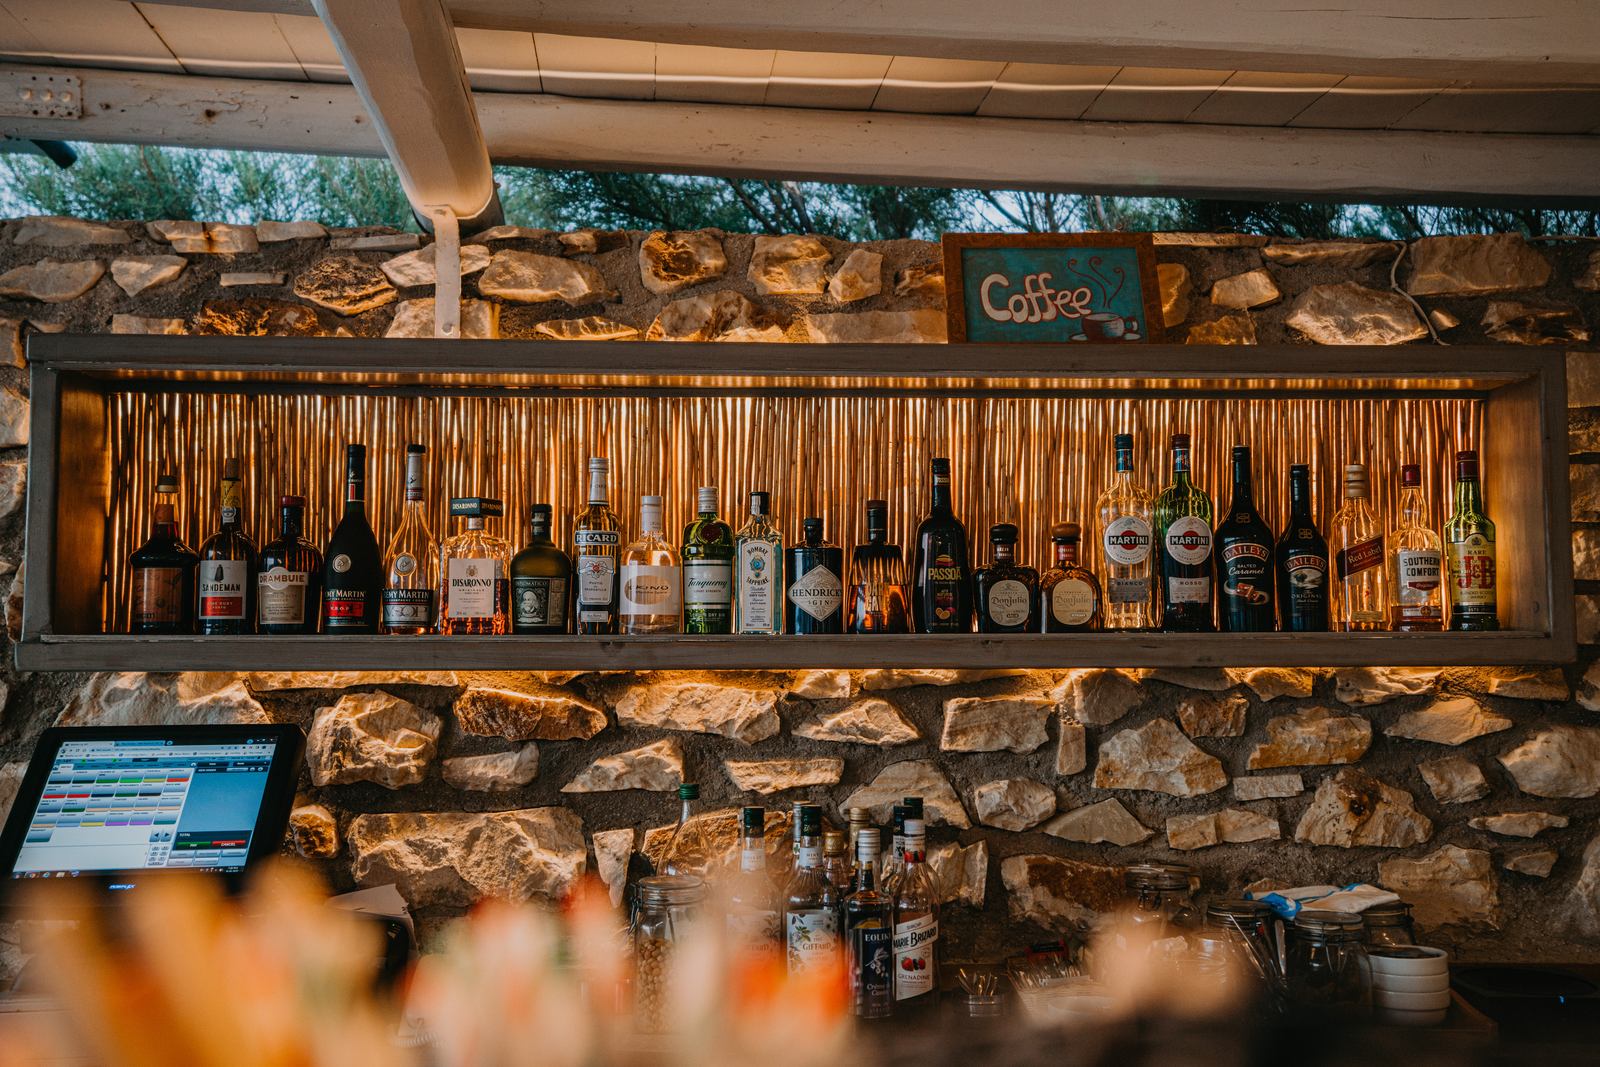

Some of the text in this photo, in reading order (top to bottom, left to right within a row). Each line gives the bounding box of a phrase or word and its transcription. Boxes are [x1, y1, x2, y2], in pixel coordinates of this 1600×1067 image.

[980, 272, 1093, 324] Coffee
[452, 502, 478, 510] DISARONNO
[576, 534, 617, 542] RICARD
[1109, 536, 1148, 545] MARTINI
[1170, 536, 1209, 545] MARTINI
[746, 546, 768, 556] BOMBAY
[1224, 546, 1267, 559] BAILEYS
[1348, 553, 1363, 564] Red
[1363, 545, 1382, 559] Label
[1286, 557, 1325, 569] BAILEYS
[1228, 566, 1264, 576] Caramel
[1406, 567, 1440, 577] COMFORT
[259, 574, 304, 583] DRAMBUIE
[452, 578, 492, 588] DISARONNO
[687, 577, 727, 589] Tanqueray
[202, 583, 241, 592] SANDEMAN
[336, 589, 365, 598] MARTIN
[399, 589, 429, 599] MARTIN
[910, 926, 937, 948] BRIZARD
